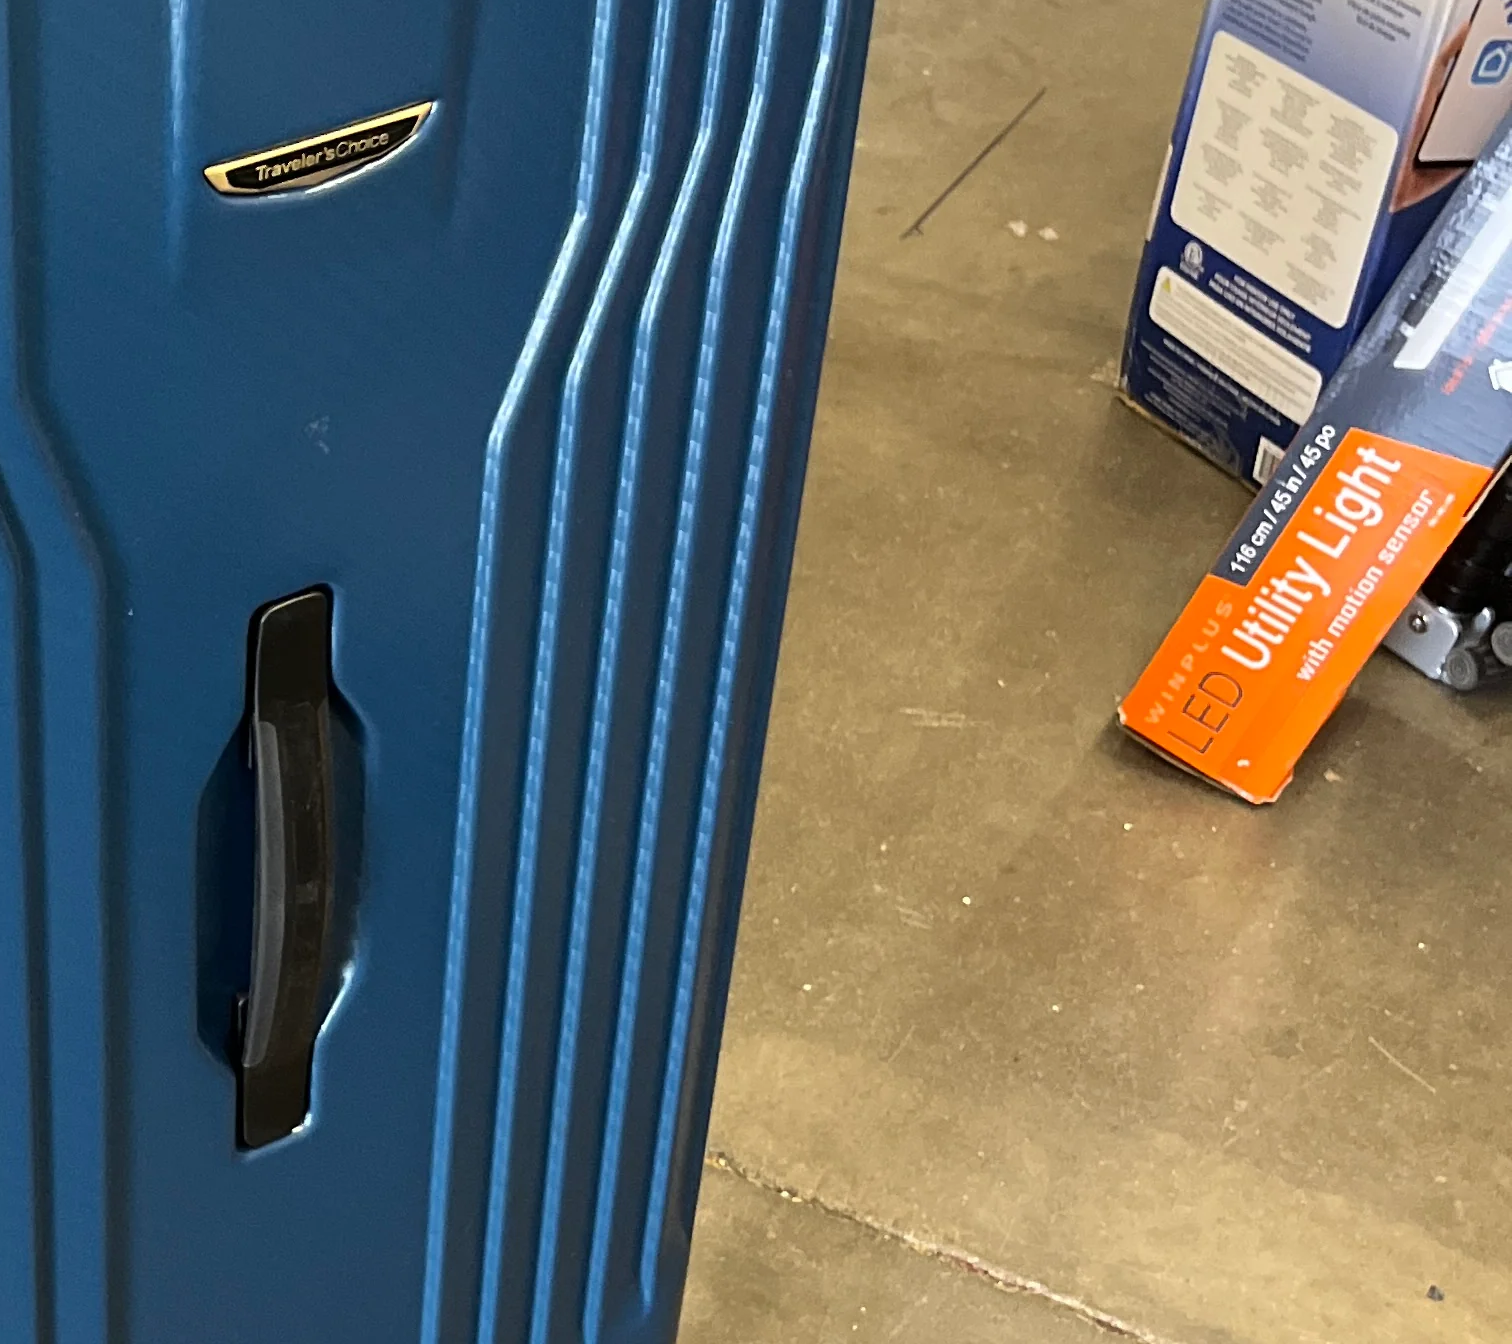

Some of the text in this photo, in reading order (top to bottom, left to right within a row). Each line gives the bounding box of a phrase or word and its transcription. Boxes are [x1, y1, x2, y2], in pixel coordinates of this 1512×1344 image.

[1317, 424, 1336, 451] po
[1299, 443, 1323, 470] 45
[1281, 474, 1303, 495] in
[1271, 489, 1292, 514] 45
[1251, 522, 1271, 548] cm
[1230, 542, 1257, 574] 116
[1296, 488, 1434, 682] with motion sensor
[1167, 446, 1402, 755] LED Utility Light
[1144, 598, 1233, 725] WINPLUS
